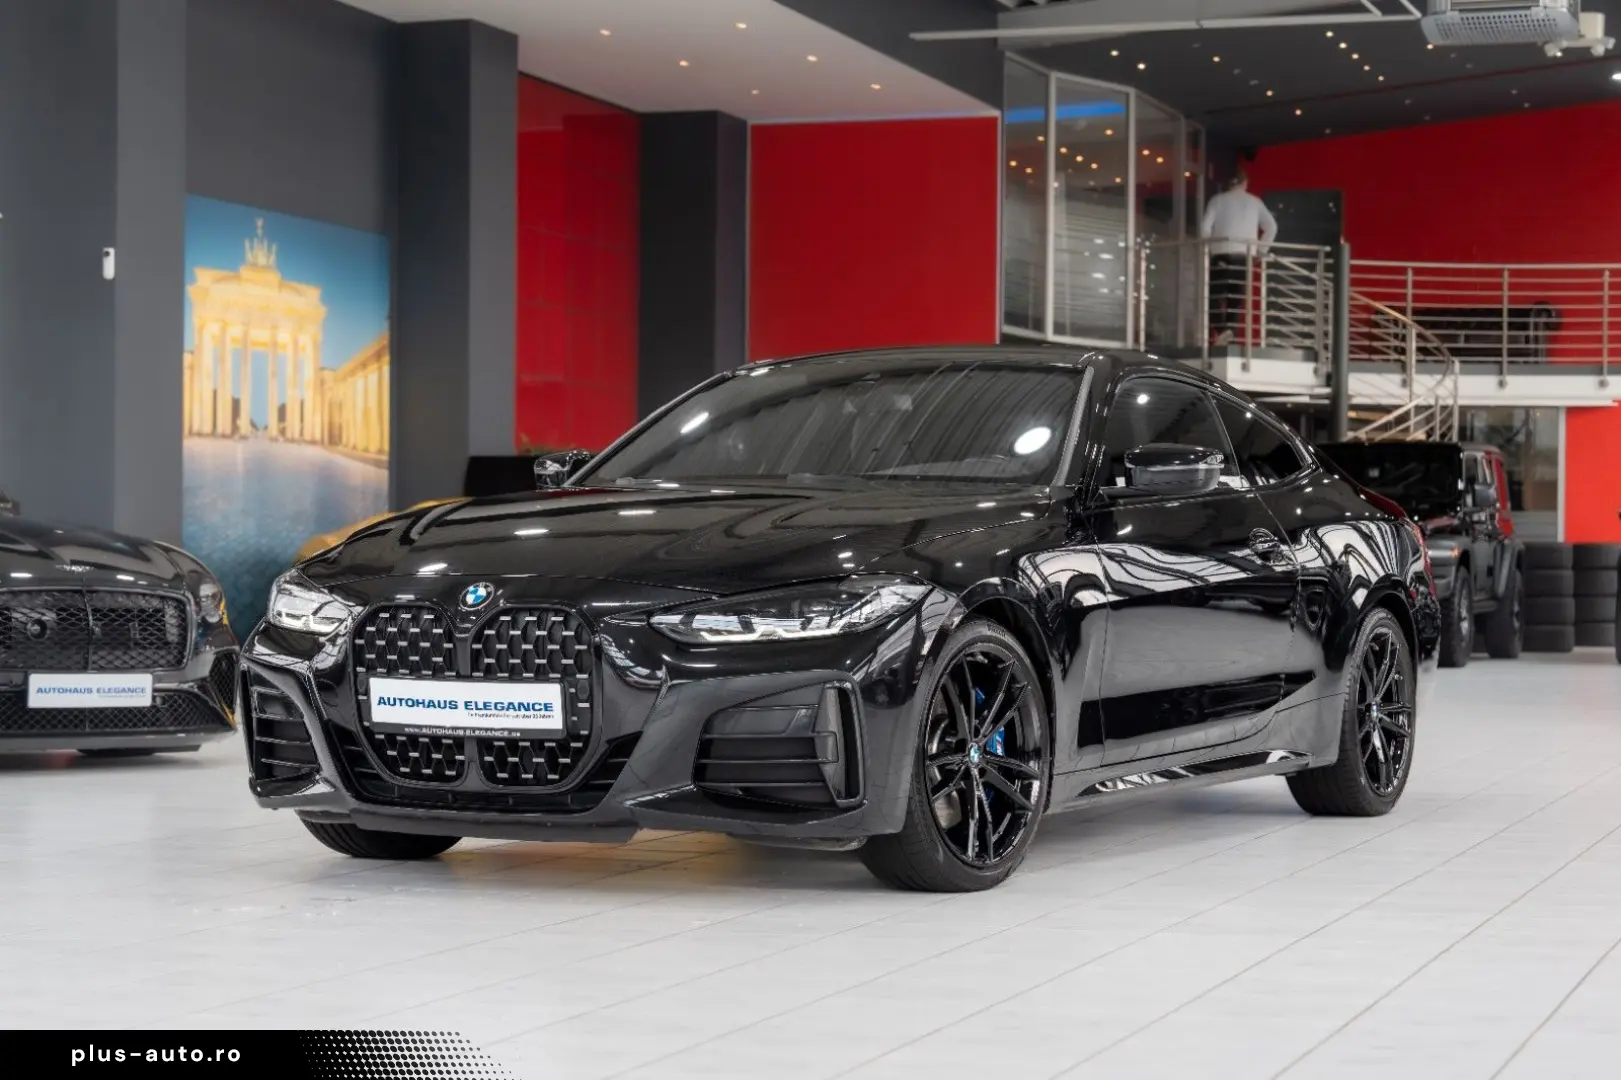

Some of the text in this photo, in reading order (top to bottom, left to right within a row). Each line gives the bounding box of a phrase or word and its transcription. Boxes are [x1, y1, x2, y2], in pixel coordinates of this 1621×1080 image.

[36, 687, 93, 695] AUTOHAUS
[377, 696, 554, 712] AUTOHAUS ELEGANCE
